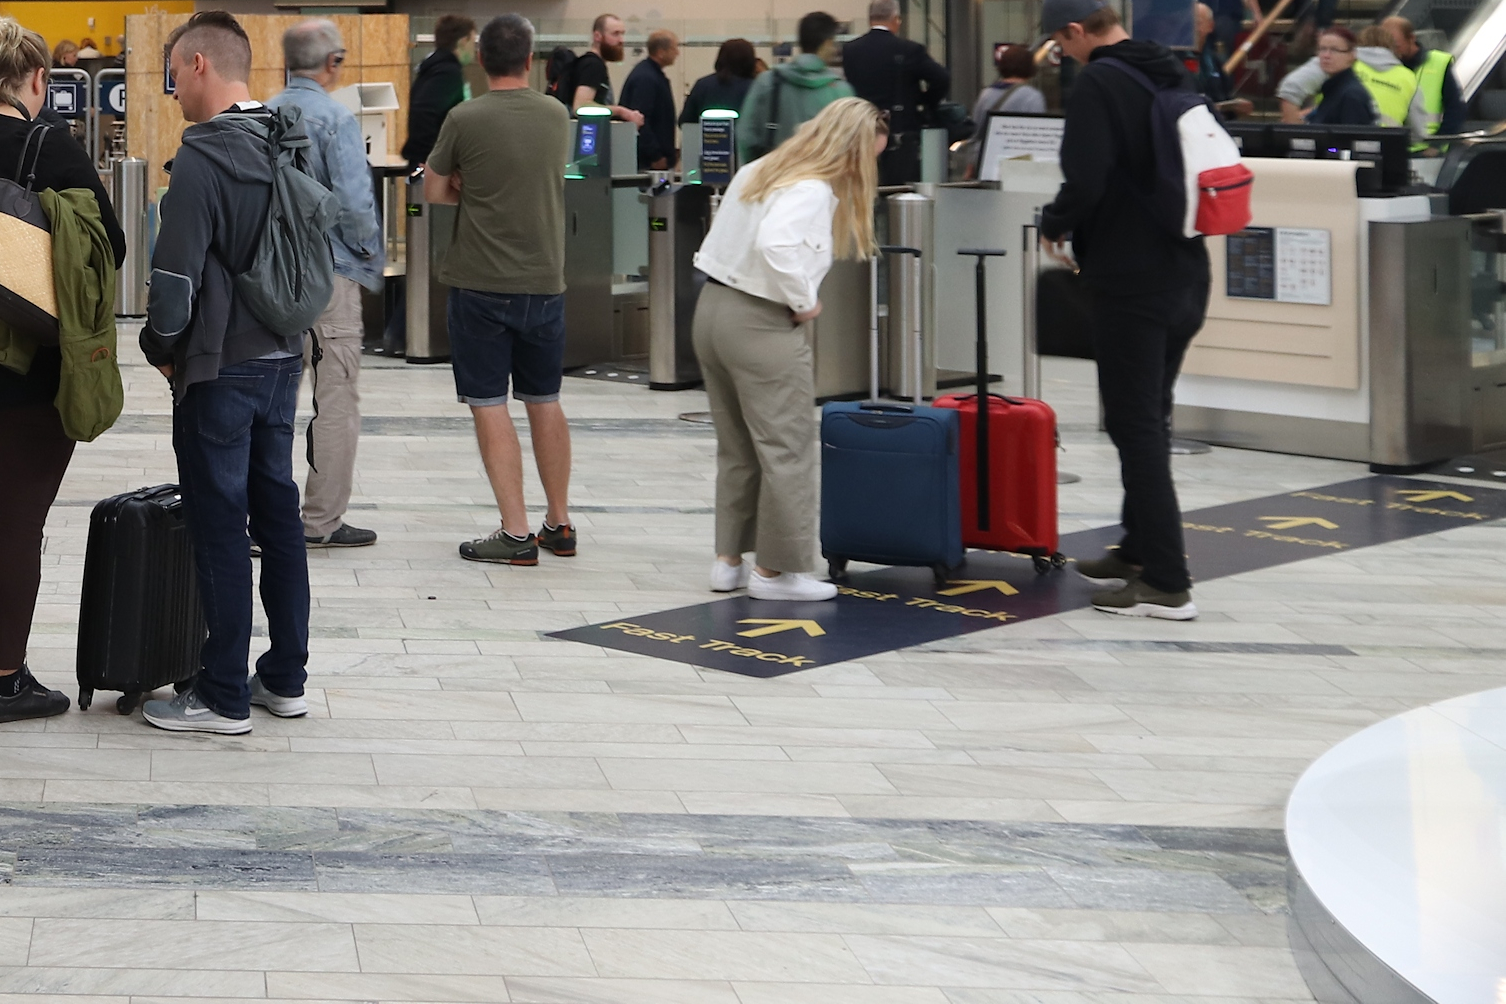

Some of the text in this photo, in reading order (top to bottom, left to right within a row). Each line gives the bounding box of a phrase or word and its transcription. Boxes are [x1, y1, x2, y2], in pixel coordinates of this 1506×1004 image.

[837, 584, 1020, 623] ast Track
[599, 621, 816, 668] Fast Track
